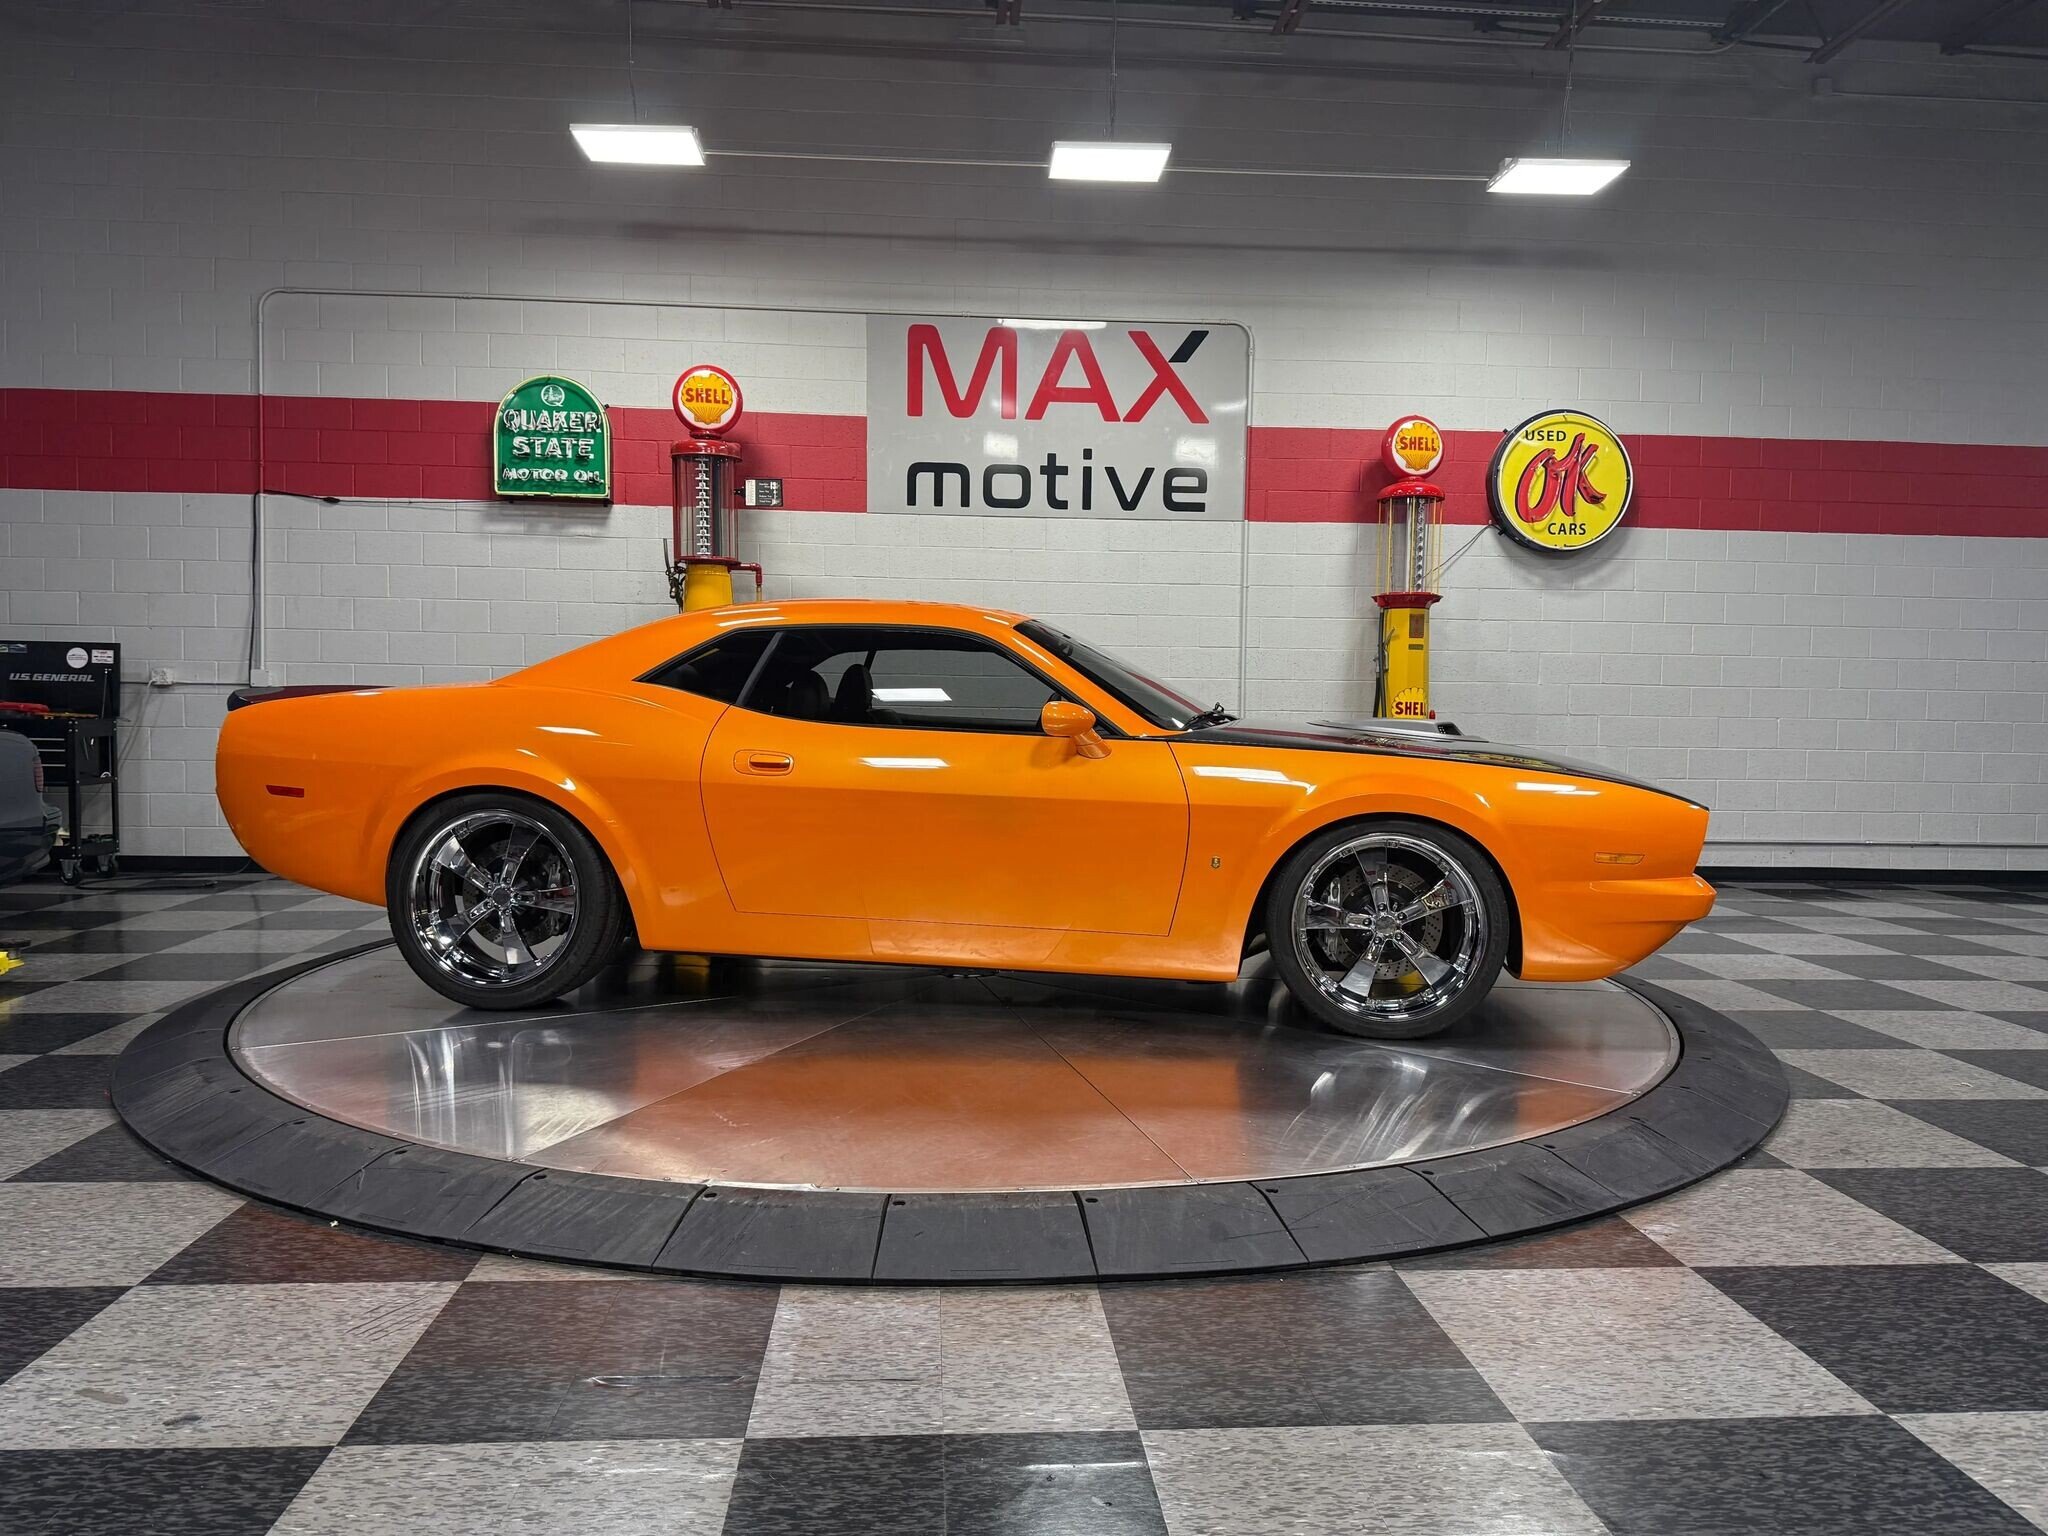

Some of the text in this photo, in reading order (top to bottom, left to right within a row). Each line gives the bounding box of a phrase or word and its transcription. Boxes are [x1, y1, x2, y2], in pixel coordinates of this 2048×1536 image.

[907, 324, 1210, 424] MAX
[685, 387, 729, 404] SHELL
[503, 409, 602, 433] QUAKER
[1399, 435, 1437, 452] SHELL
[1524, 429, 1567, 442] USED
[512, 436, 595, 459] STATE
[502, 467, 569, 481] MOTOR
[906, 448, 1208, 513] motive
[1515, 433, 1607, 523] OK
[1548, 522, 1587, 536] CARS
[32, 673, 95, 682] GENERAL
